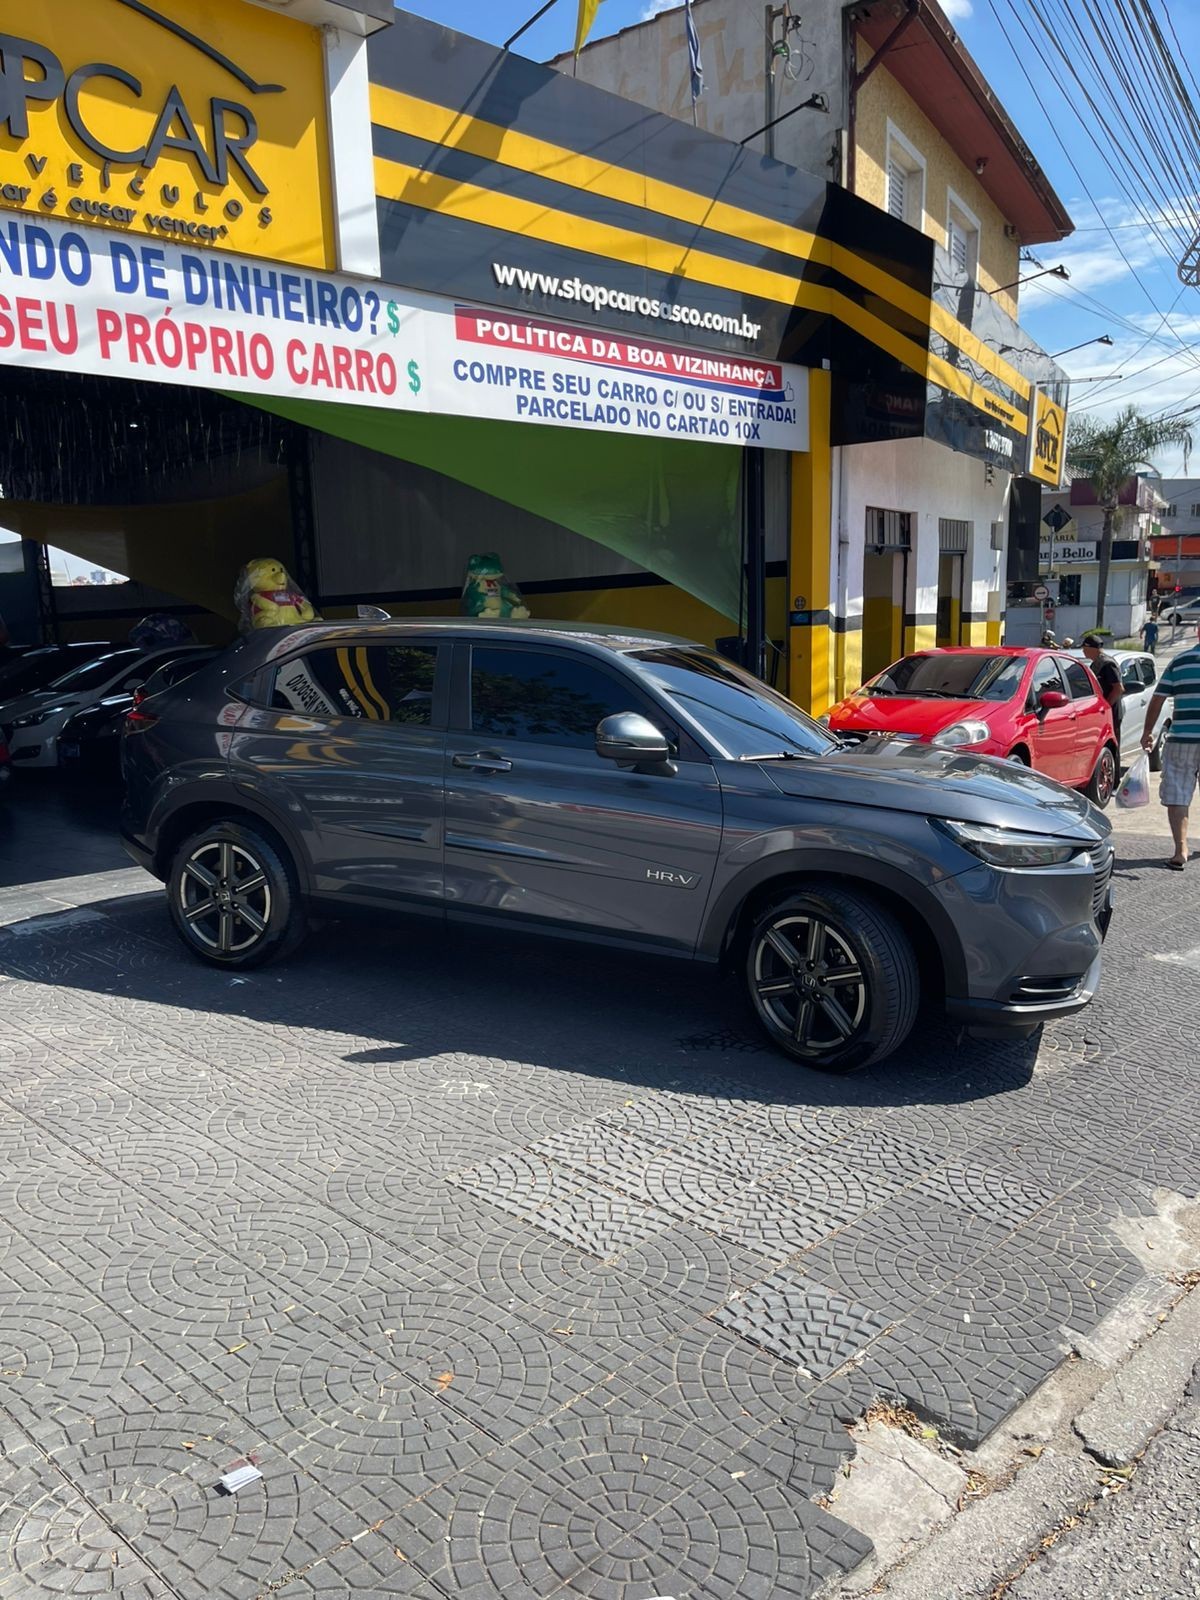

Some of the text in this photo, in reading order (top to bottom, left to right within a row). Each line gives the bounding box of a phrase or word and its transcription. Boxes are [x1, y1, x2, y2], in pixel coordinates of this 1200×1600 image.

[0, 33, 270, 196] PCAR
[0, 182, 31, 203] ar
[42, 186, 58, 209] é
[69, 196, 137, 223] ousar
[109, 240, 169, 301] DE
[181, 254, 381, 336] DINHEIRO?
[492, 262, 761, 340] www.stopcarosasco.com.br
[0, 293, 79, 356] SEU
[96, 306, 275, 381] PRÓPRIO
[286, 338, 397, 396] CARRO
[476, 318, 776, 387] POLÍTICA DA BOA VIZINHANÇA
[453, 359, 797, 425] COMPRE SEU CARRO C/ OU S/ ENTRADA!
[516, 394, 761, 440] PARCELADO NO CARTAO 10X
[1062, 547, 1094, 559] Bello
[646, 868, 694, 885] HR-V
